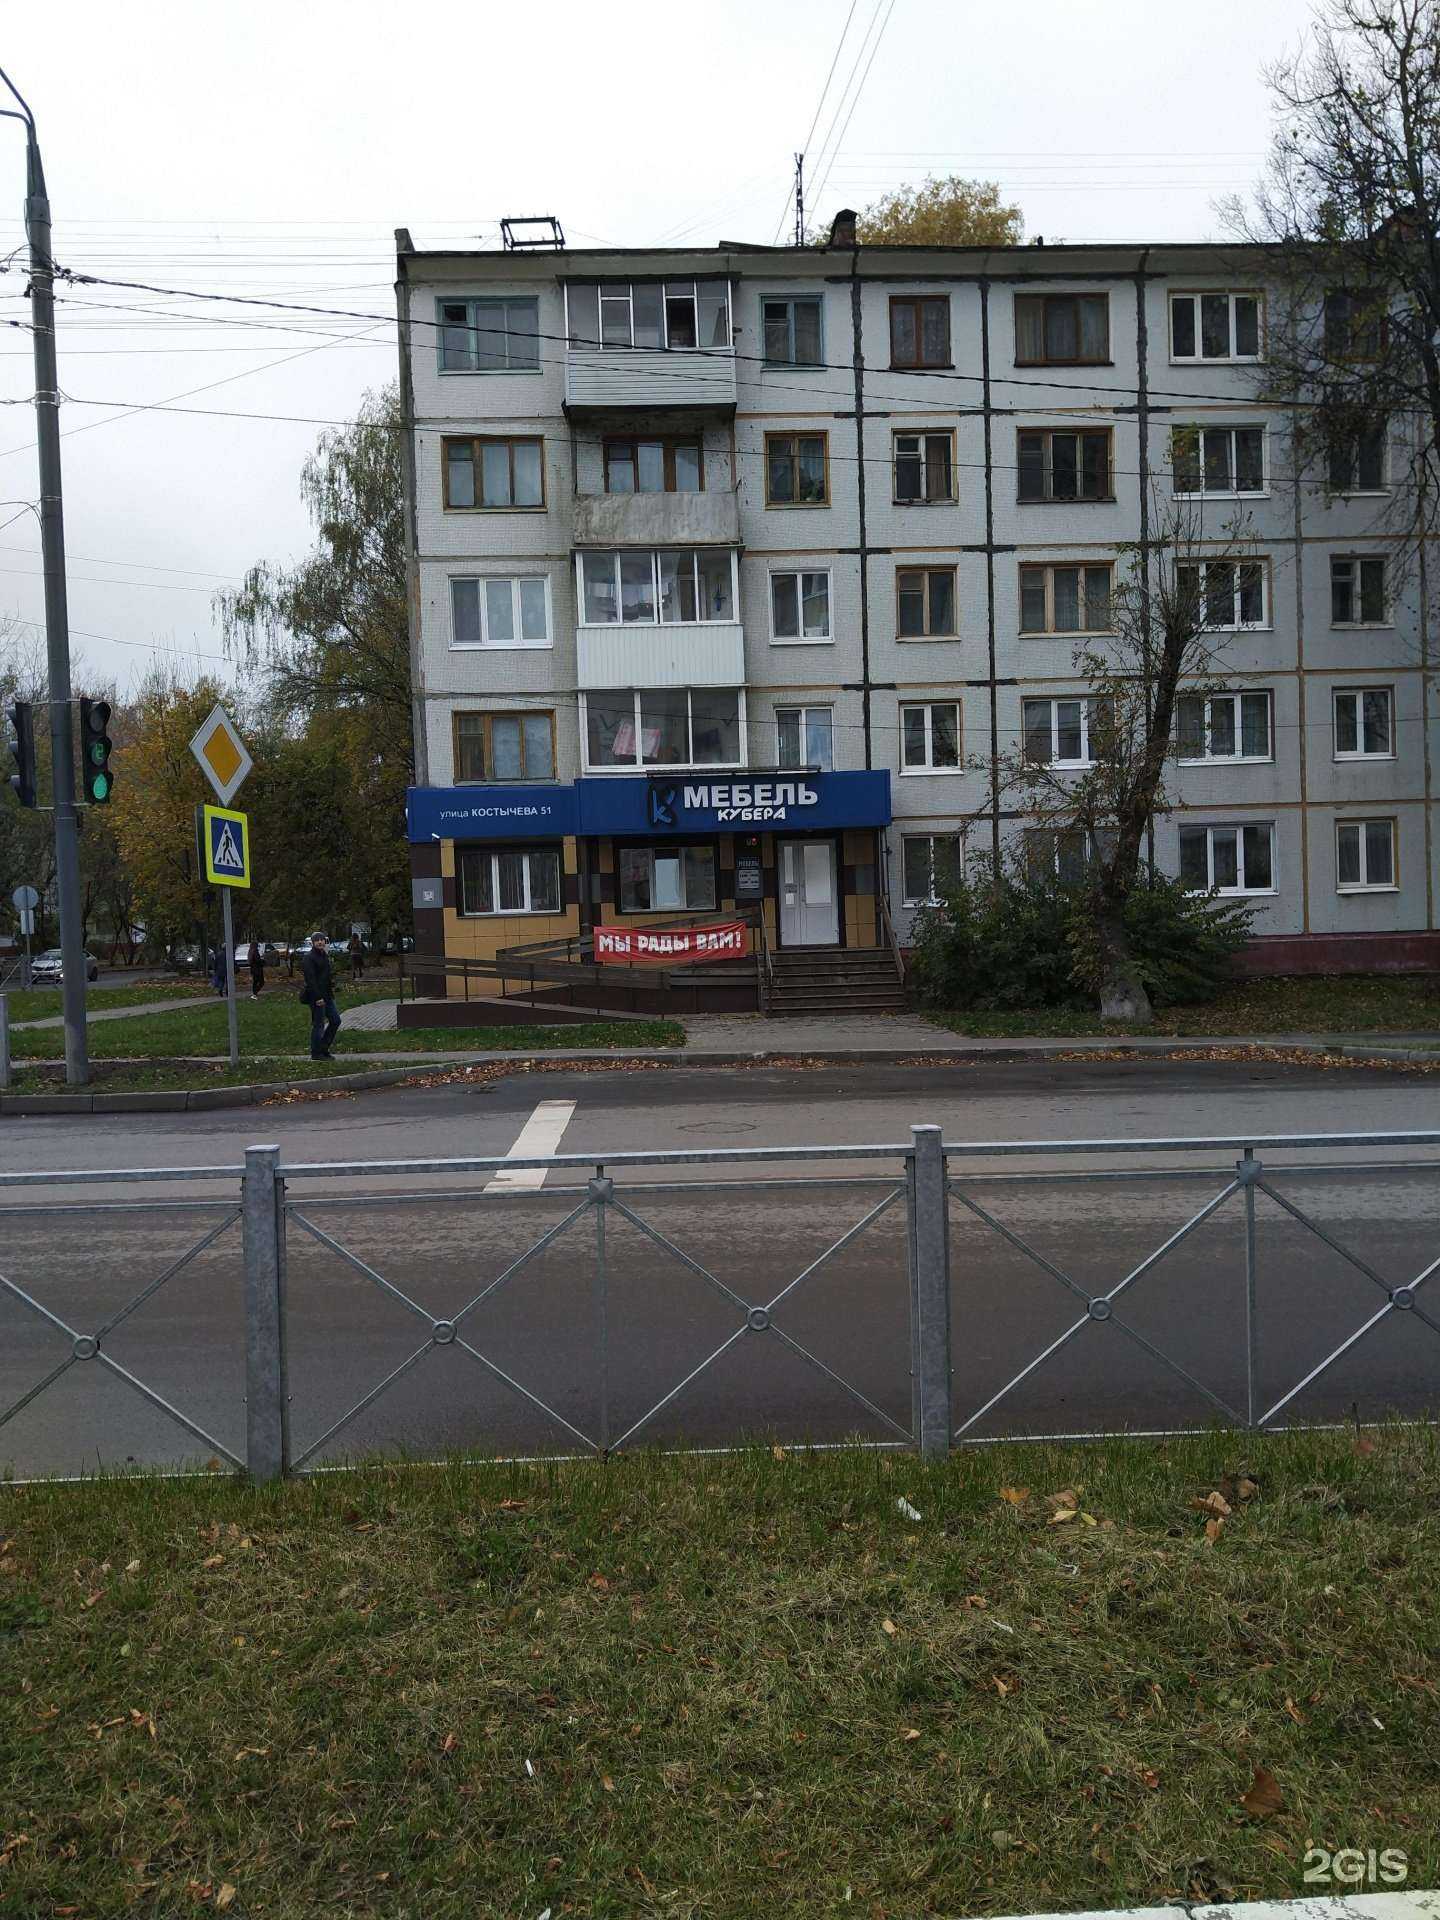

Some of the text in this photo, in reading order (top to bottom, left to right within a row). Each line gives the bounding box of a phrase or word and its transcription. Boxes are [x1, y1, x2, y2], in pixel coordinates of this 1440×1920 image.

[683, 783, 819, 809] МЕБЕЛЬ
[440, 806, 552, 820] улица КОСТЫЧЕВА 51
[717, 807, 786, 822] КУБЕРА
[599, 931, 742, 954] МЫ РАДЫ ВАМ!
